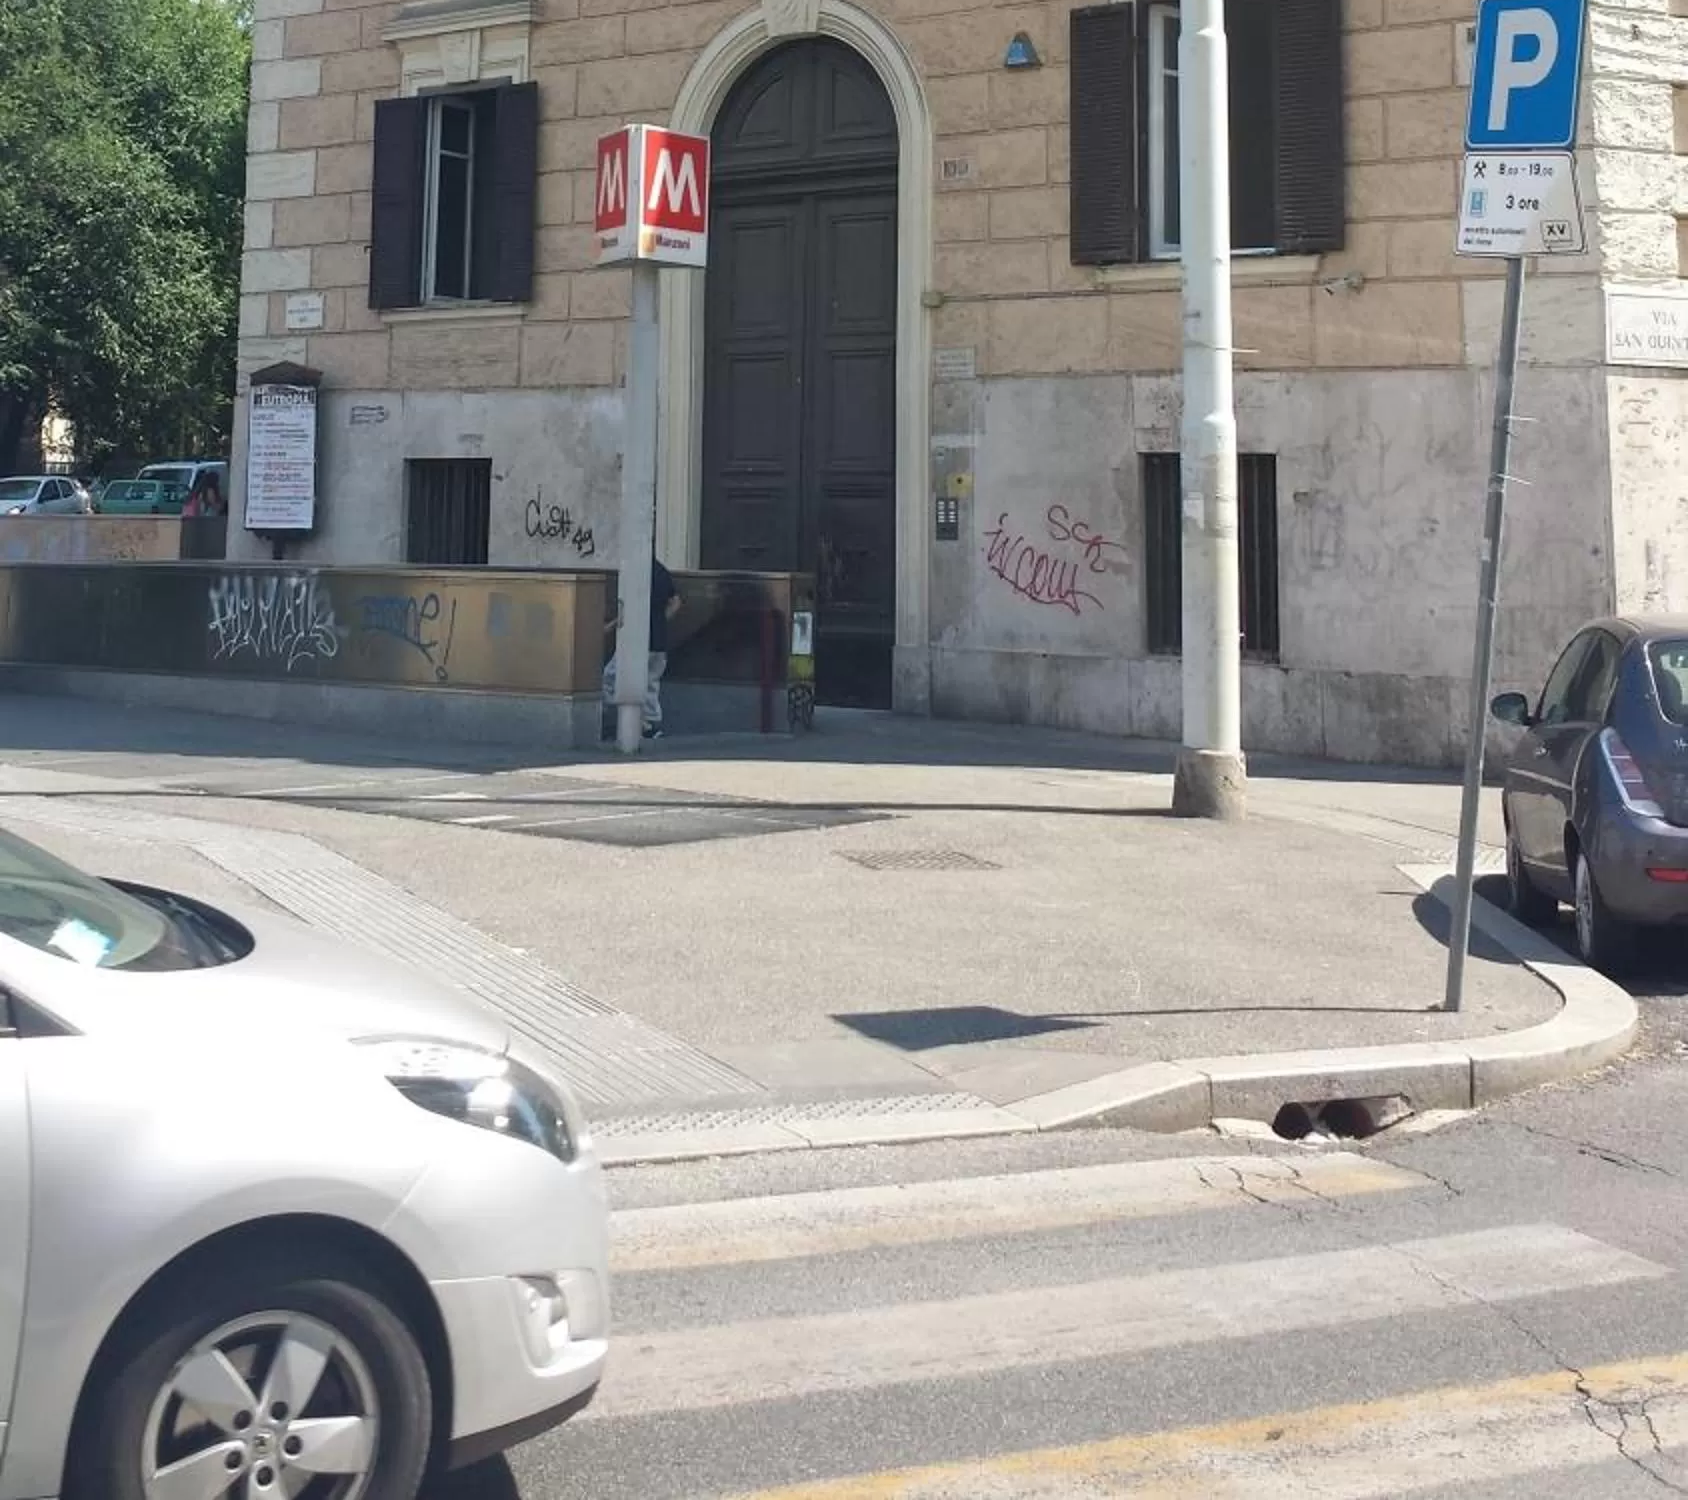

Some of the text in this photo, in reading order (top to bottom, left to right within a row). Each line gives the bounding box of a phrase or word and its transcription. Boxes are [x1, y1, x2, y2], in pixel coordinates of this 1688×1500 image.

[1487, 7, 1559, 132] P
[598, 147, 625, 217] M
[647, 147, 701, 217] M
[1505, 194, 1539, 211] 3 ore
[1546, 223, 1566, 236] XV
[1651, 309, 1677, 326] VIA
[1614, 332, 1643, 349] SAN
